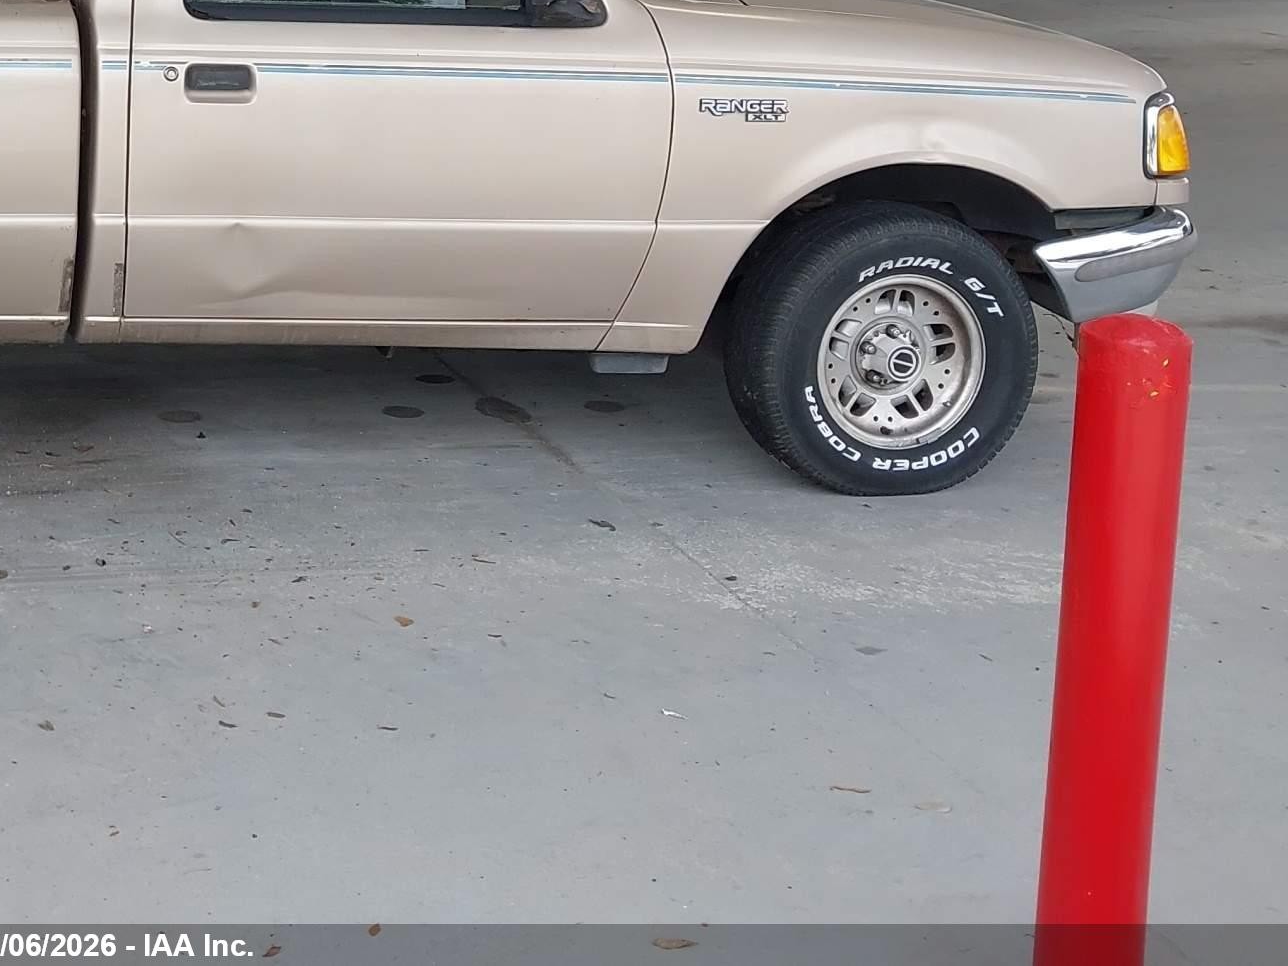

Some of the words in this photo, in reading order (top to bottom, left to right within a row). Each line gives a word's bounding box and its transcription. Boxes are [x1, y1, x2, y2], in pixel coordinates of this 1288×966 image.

[857, 256, 955, 283] RADIAL
[962, 276, 1005, 318] G/T
[803, 384, 862, 462] COBRA
[872, 426, 981, 472] COOPER
